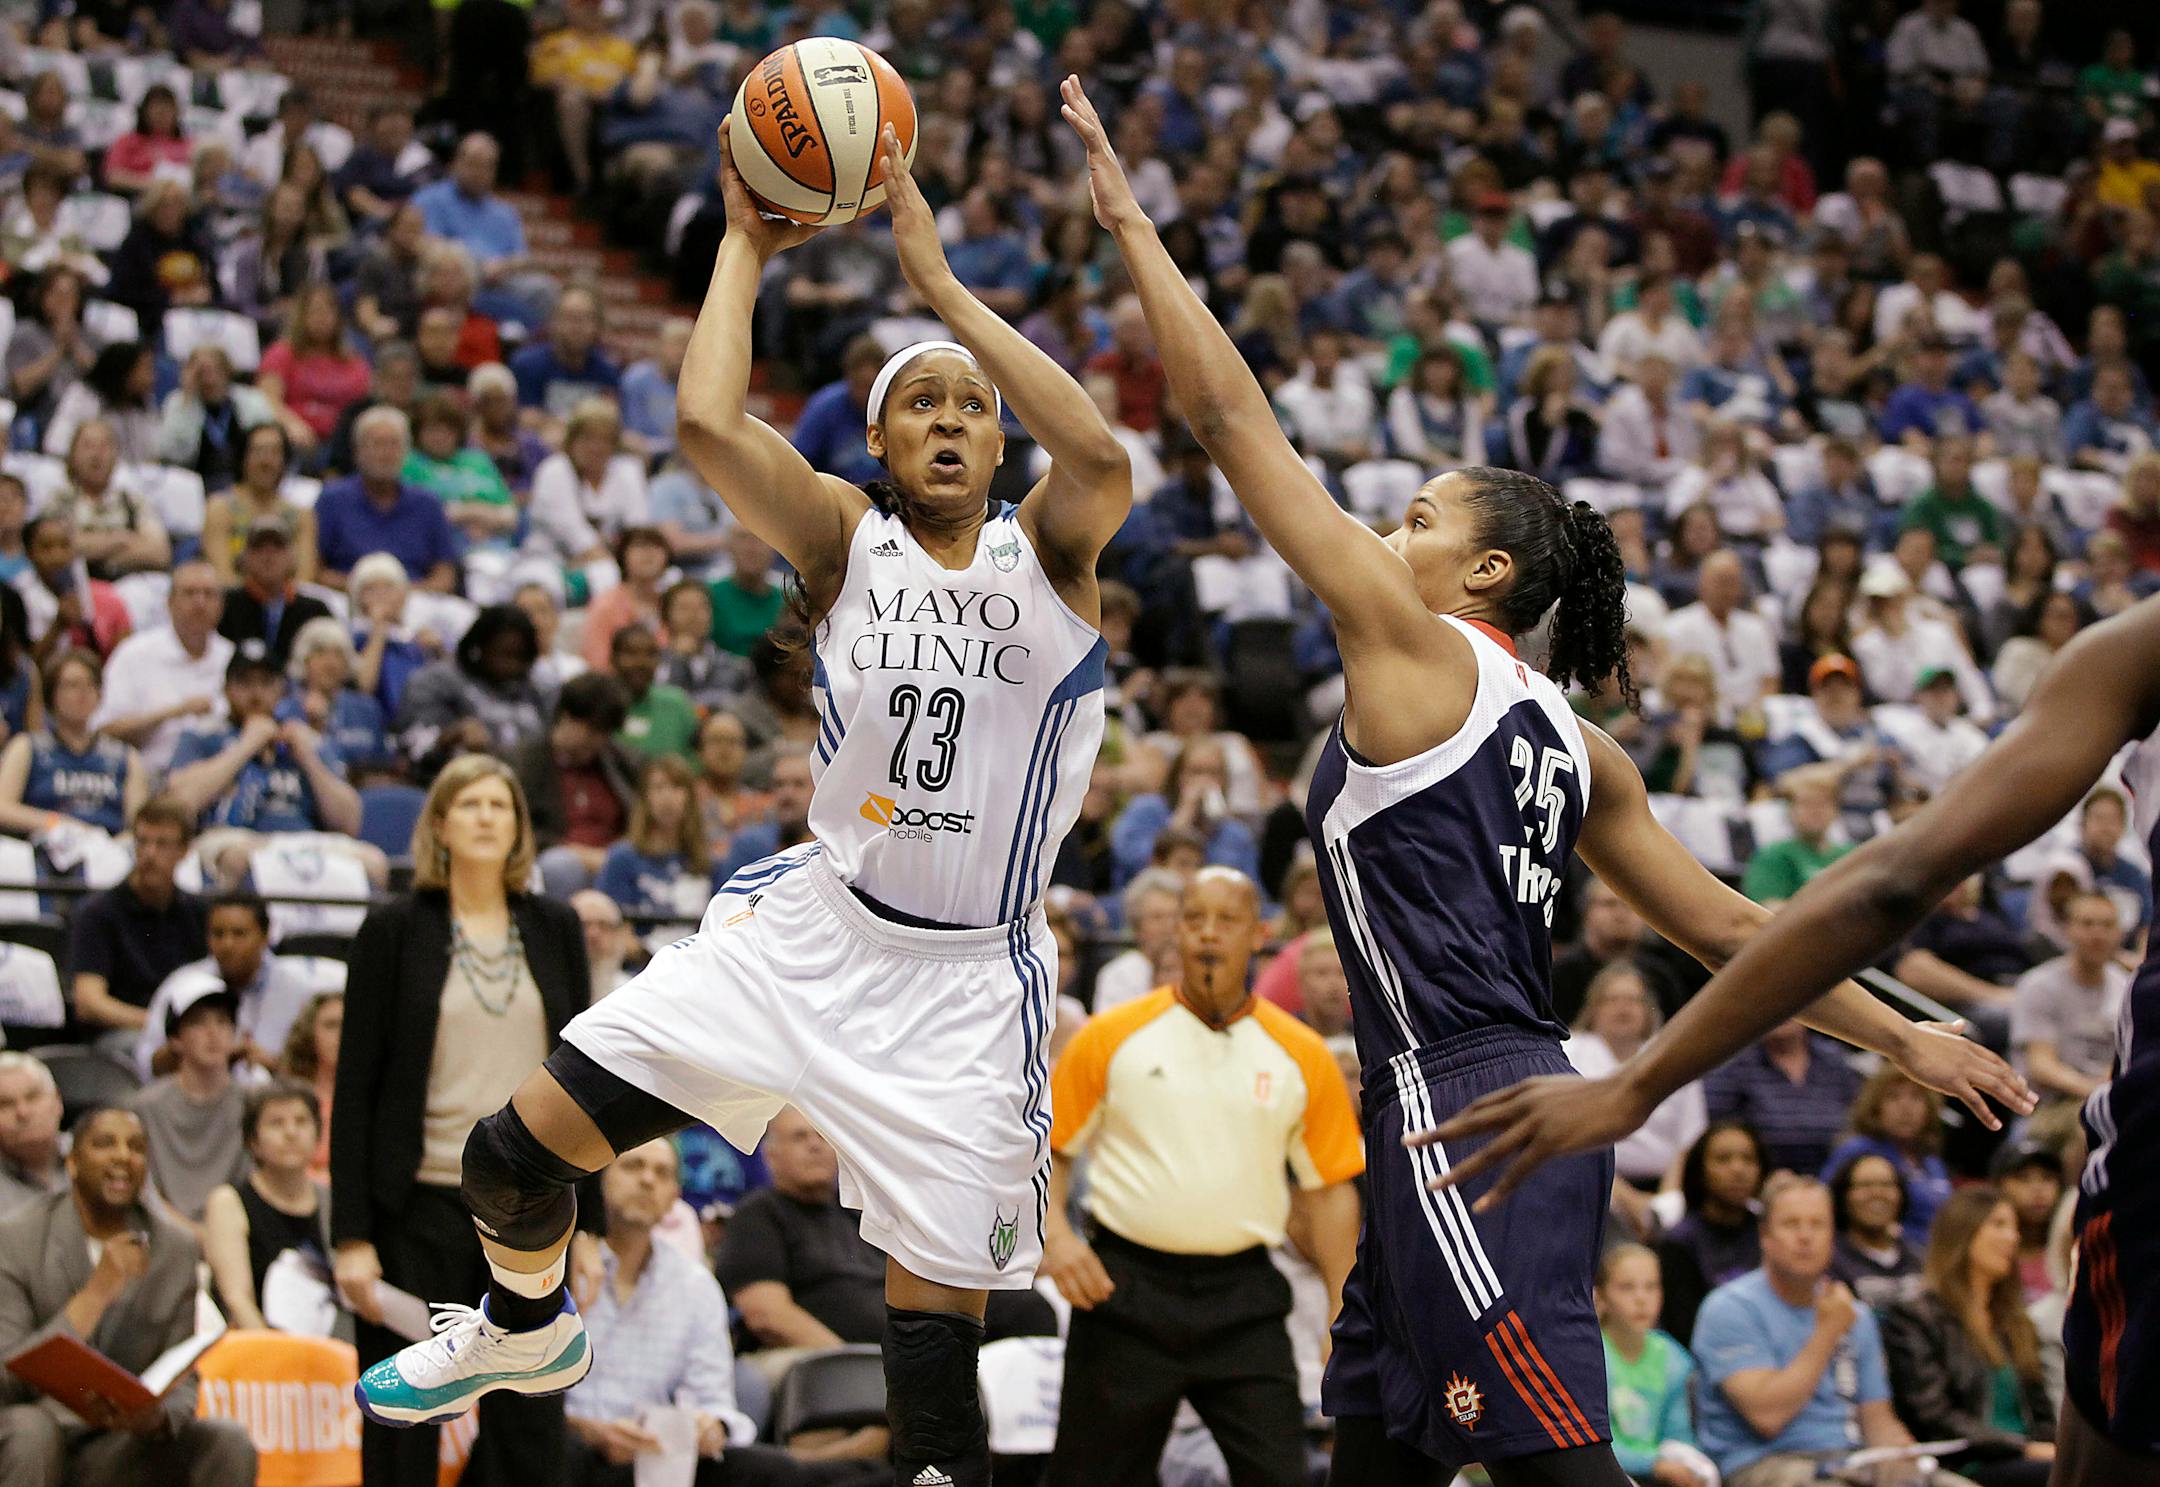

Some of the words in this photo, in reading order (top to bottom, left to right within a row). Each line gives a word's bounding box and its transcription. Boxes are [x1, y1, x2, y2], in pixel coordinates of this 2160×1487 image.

[763, 49, 818, 158] SPALDING
[869, 548, 904, 557] adidas
[866, 587, 1020, 631] MAYO
[851, 632, 1031, 685] CLINIC
[889, 683, 966, 793] 23
[1510, 734, 1574, 855] 25
[891, 806, 975, 834] boost
[996, 1226, 1016, 1257] M
[1454, 1390, 1472, 1412] C
[912, 1475, 953, 1486] adidas
